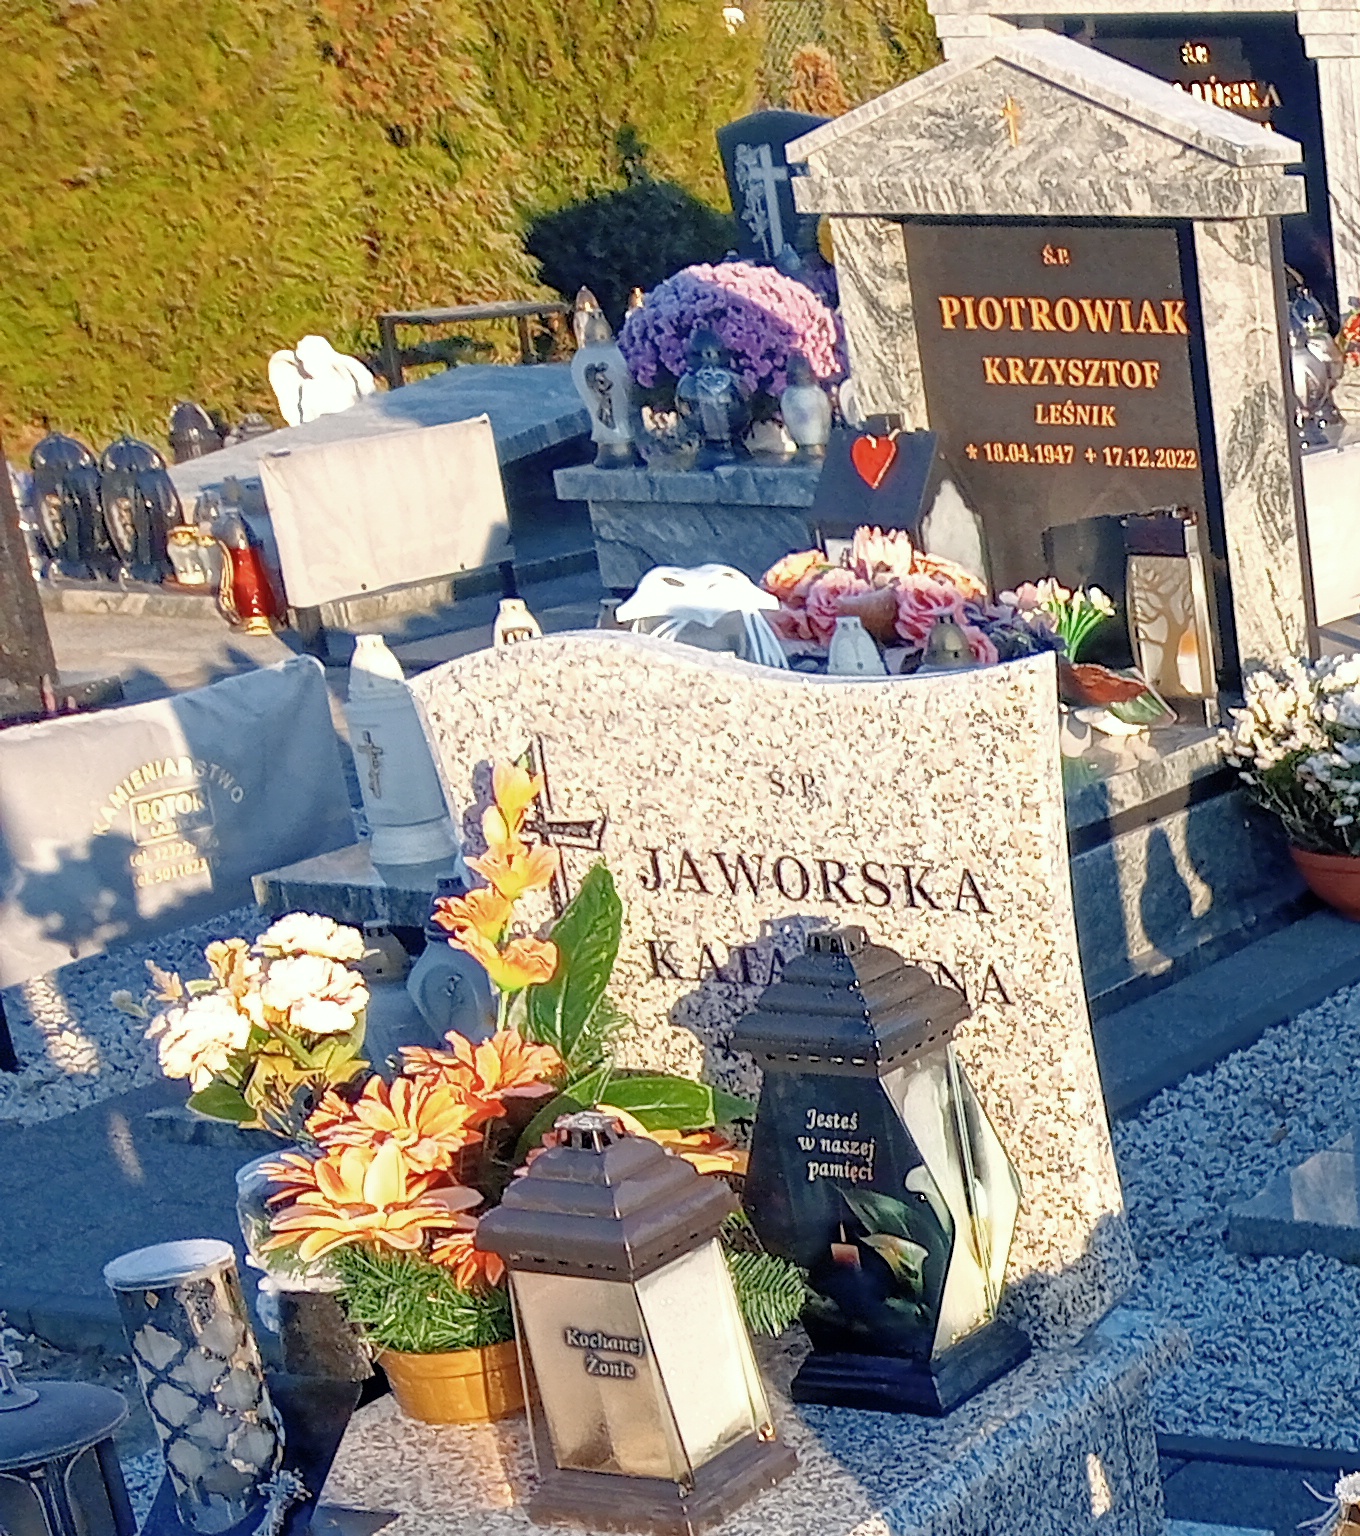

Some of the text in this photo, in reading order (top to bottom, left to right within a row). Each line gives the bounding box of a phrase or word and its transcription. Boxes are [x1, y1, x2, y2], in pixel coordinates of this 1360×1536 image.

[938, 295, 1188, 335] PIOTROWIAK
[982, 356, 1161, 389] KRZYSZTOF
[1035, 400, 1117, 427] LEŚNIK
[983, 442, 1198, 469] 18.04.1947 17.12.2022
[92, 756, 244, 836] KAMIENIARSTWO
[640, 846, 992, 915] JAWORSKA
[647, 938, 1014, 1006] KATANA
[806, 1108, 859, 1131] Jesteś
[798, 1136, 875, 1162] w naszej
[807, 1160, 874, 1184] pamięci
[565, 1328, 646, 1358] Kochanej
[585, 1352, 636, 1379] Żonie
